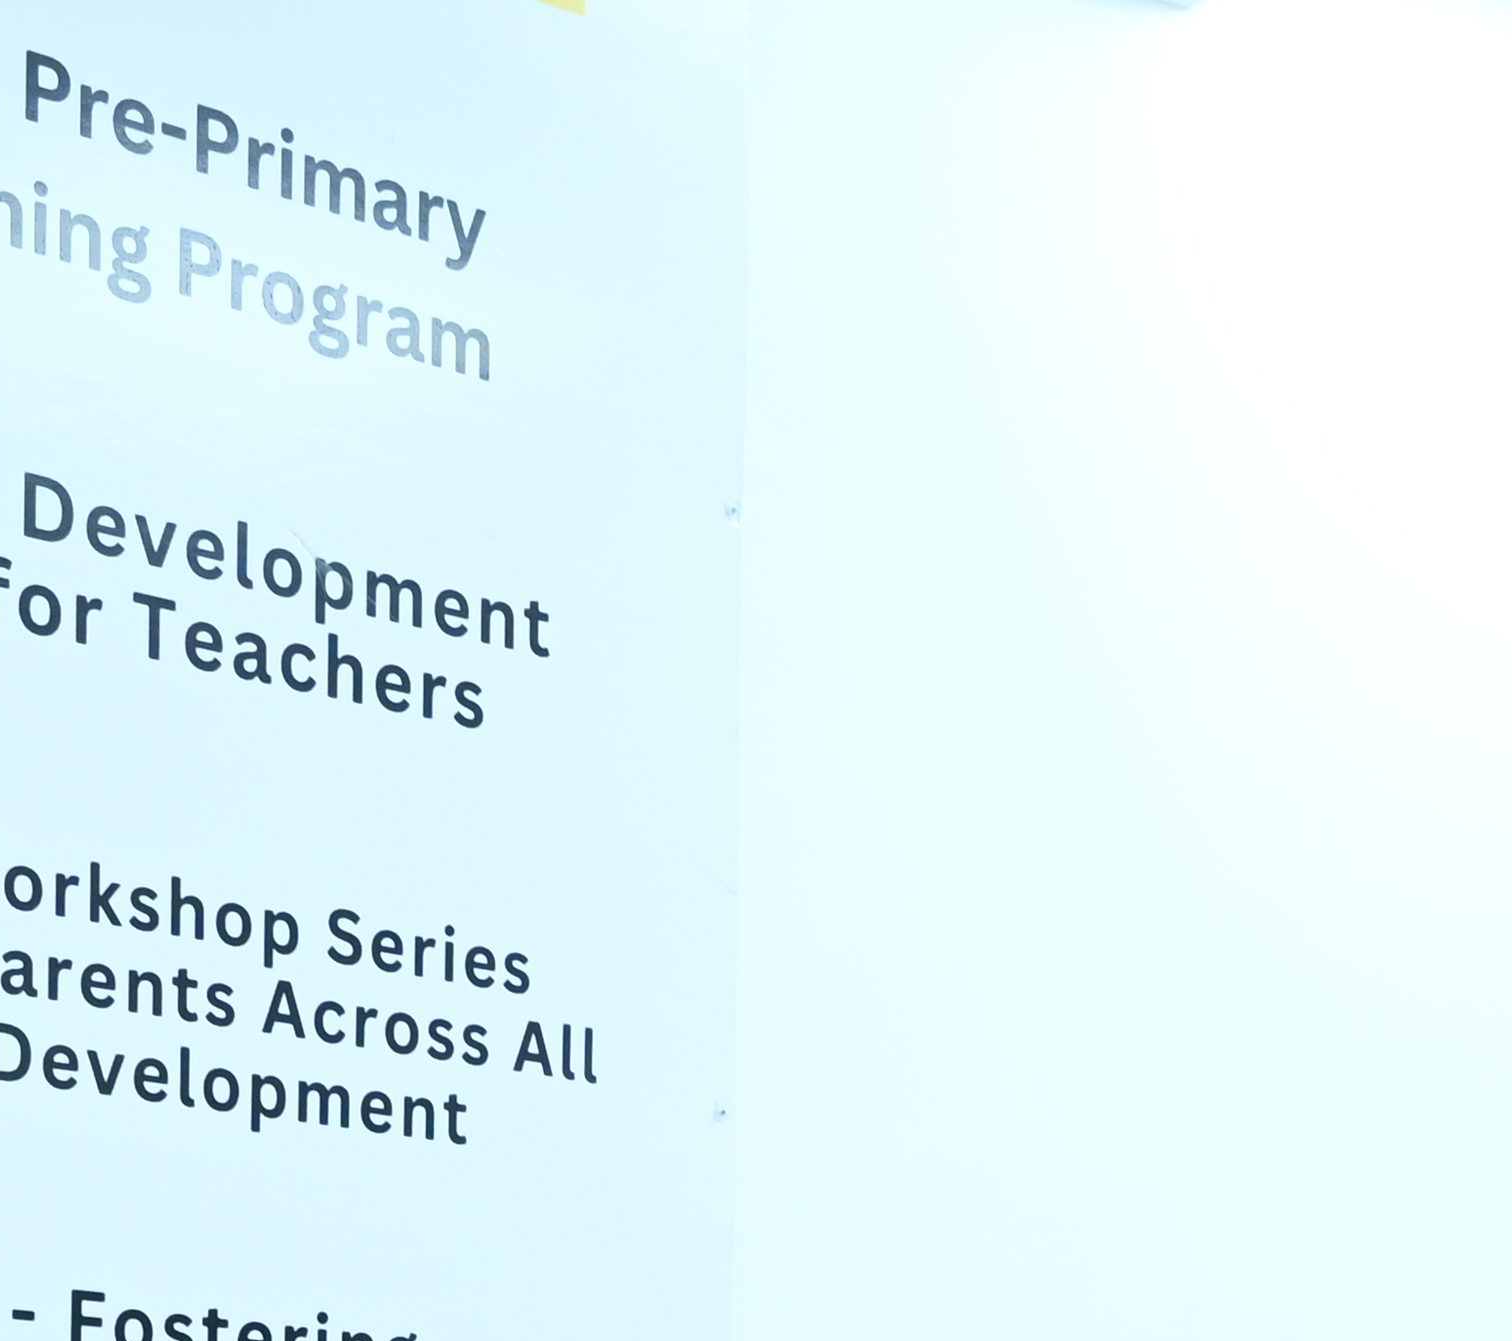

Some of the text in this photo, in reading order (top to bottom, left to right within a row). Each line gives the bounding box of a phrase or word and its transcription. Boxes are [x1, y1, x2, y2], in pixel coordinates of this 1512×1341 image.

[24, 49, 487, 272] Pre-Primary
[178, 227, 490, 382] Program
[23, 471, 551, 659] Development
[132, 591, 485, 730] Teachers
[326, 907, 531, 995] Series
[261, 979, 490, 1067] Across
[512, 1020, 598, 1085] All
[11, 1308, 36, 1322] -
